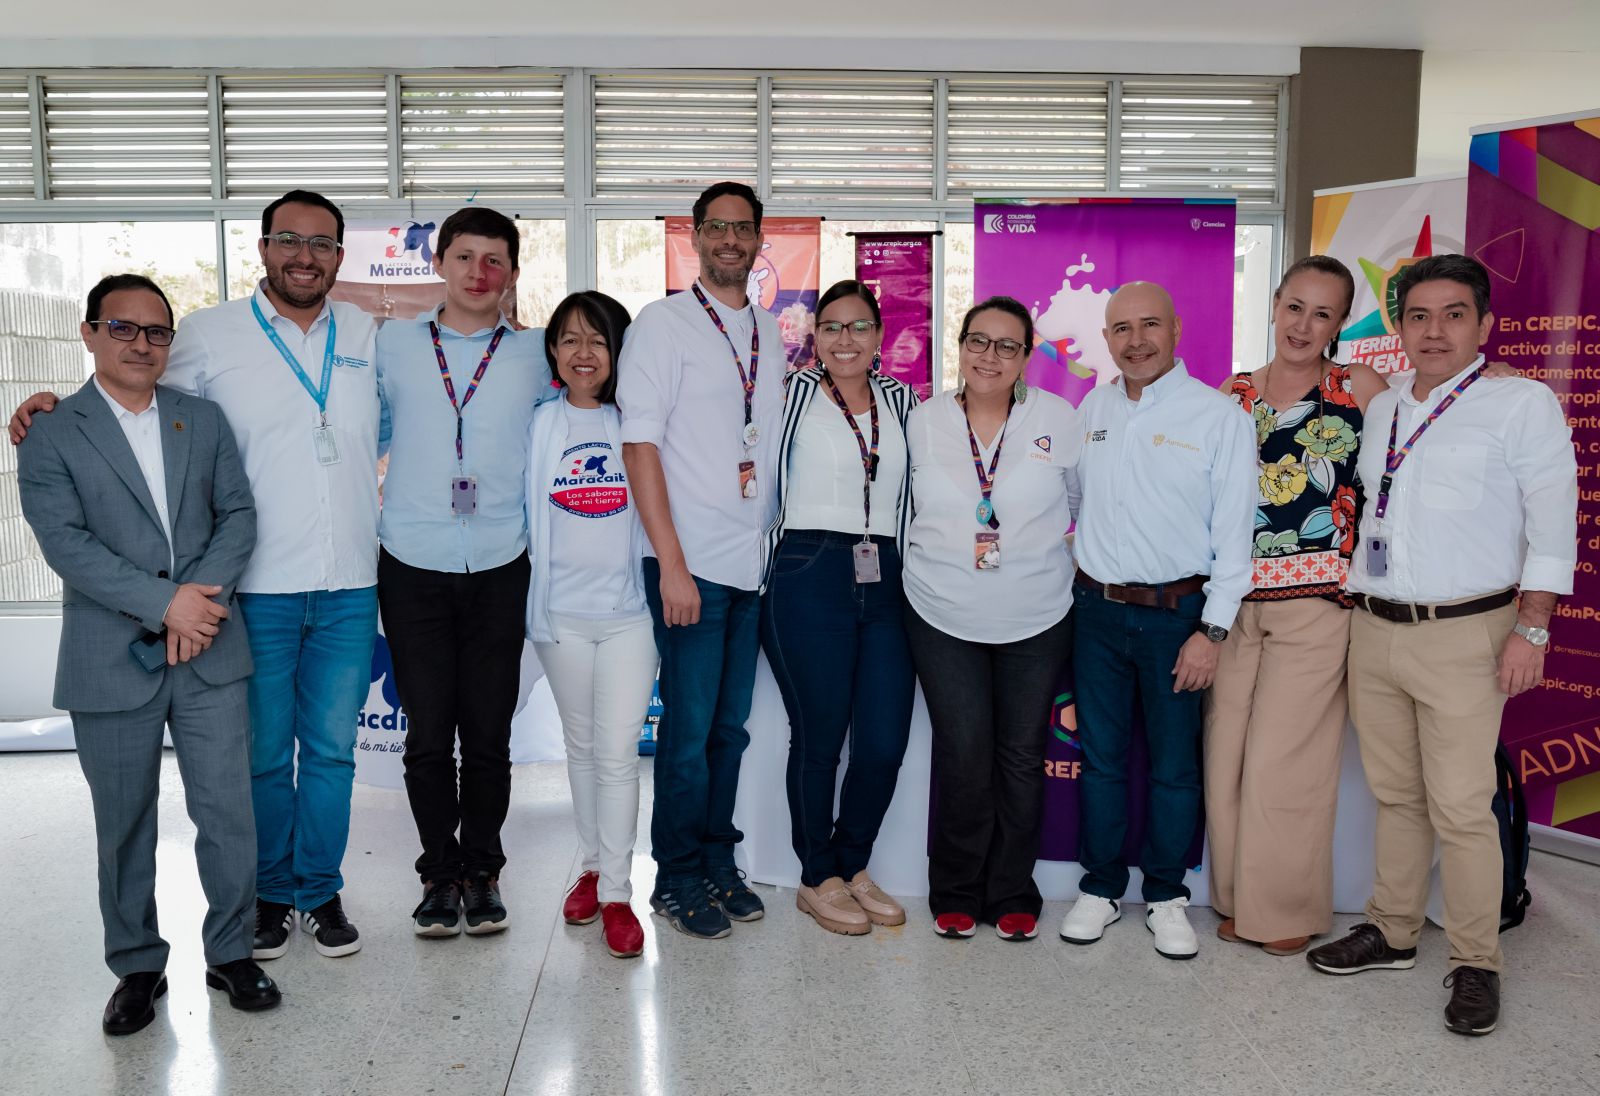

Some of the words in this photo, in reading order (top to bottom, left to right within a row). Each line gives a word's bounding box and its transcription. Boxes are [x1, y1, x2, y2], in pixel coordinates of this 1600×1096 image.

[1007, 223, 1036, 233] VIDA
[1499, 317, 1522, 332] En
[1525, 314, 1600, 332] CREPIC,
[1498, 341, 1552, 356] activa
[1555, 340, 1581, 355] del
[585, 490, 624, 498] sabores
[359, 737, 372, 752] de
[372, 740, 389, 753] mi
